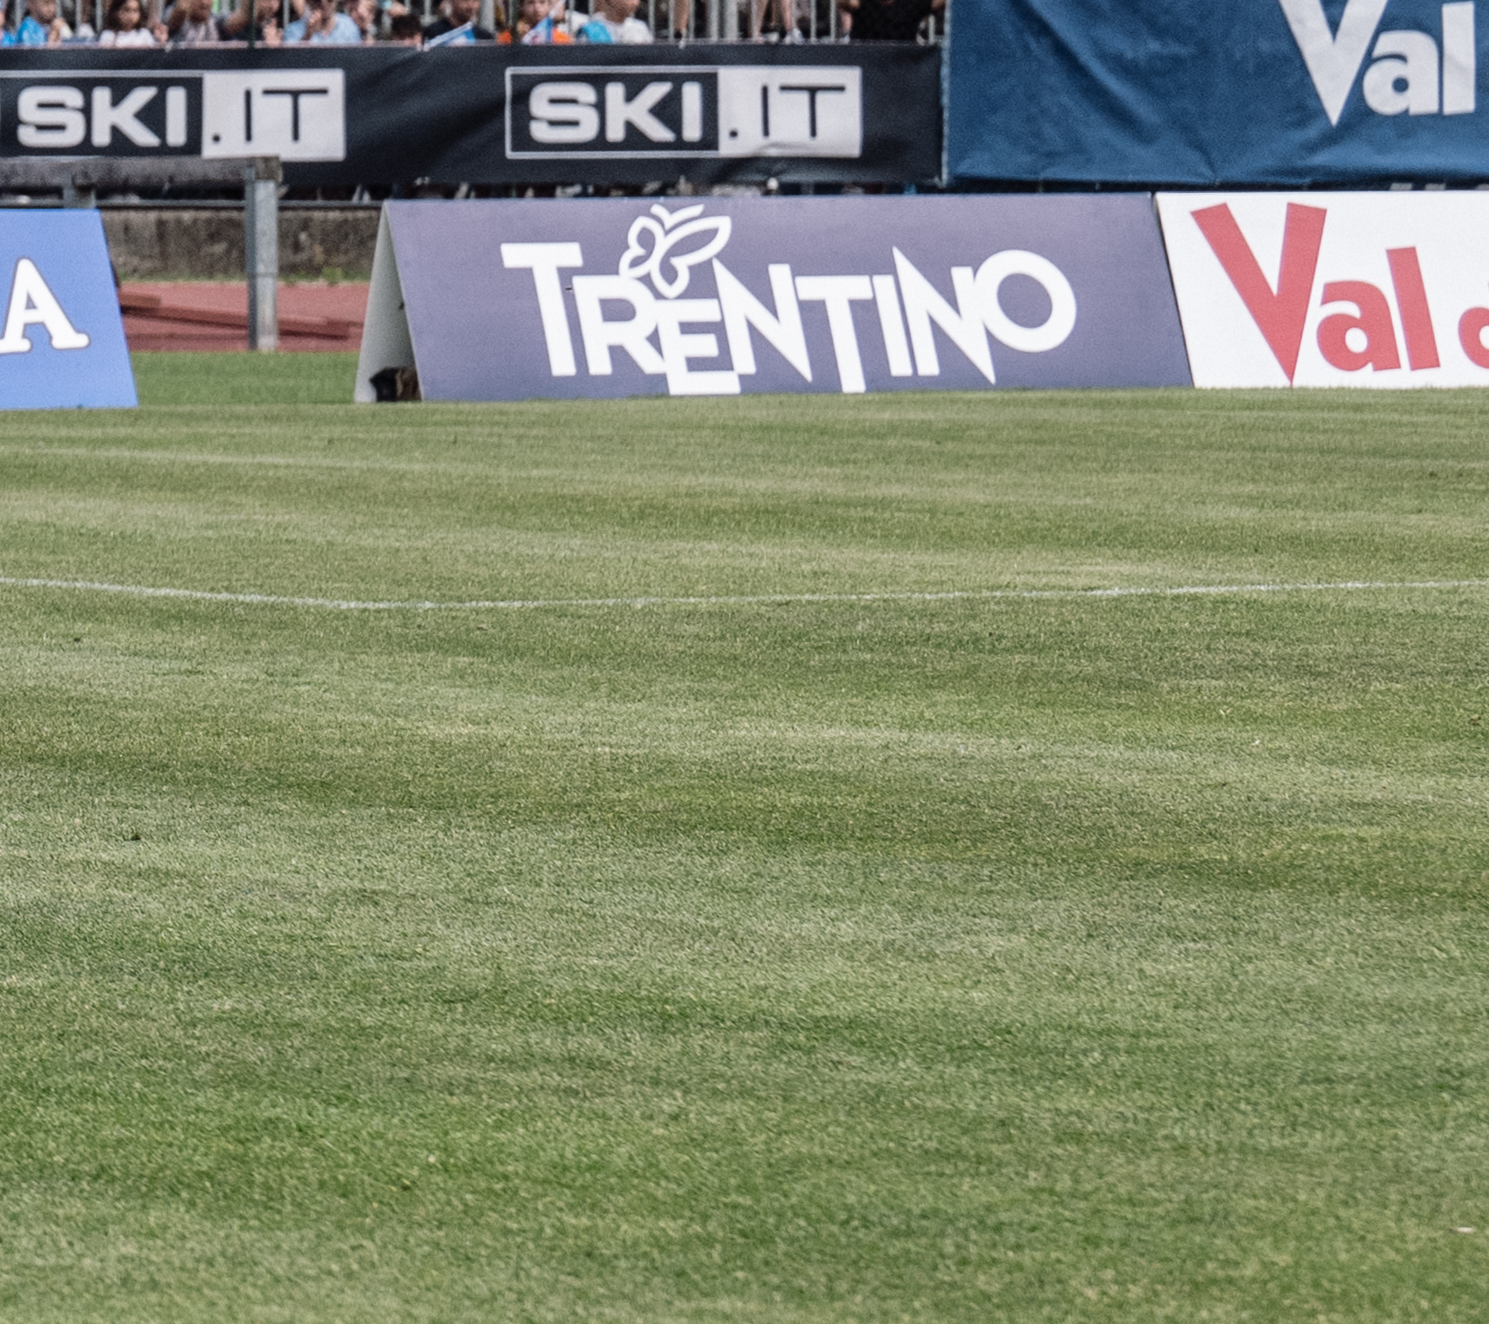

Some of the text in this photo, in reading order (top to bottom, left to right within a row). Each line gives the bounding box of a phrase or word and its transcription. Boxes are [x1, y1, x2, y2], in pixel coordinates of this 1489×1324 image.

[17, 85, 330, 148] SKI.IT
[529, 81, 847, 143] SKI.IT
[500, 241, 1077, 396] TRENTINO
[1189, 202, 1442, 387] Val
